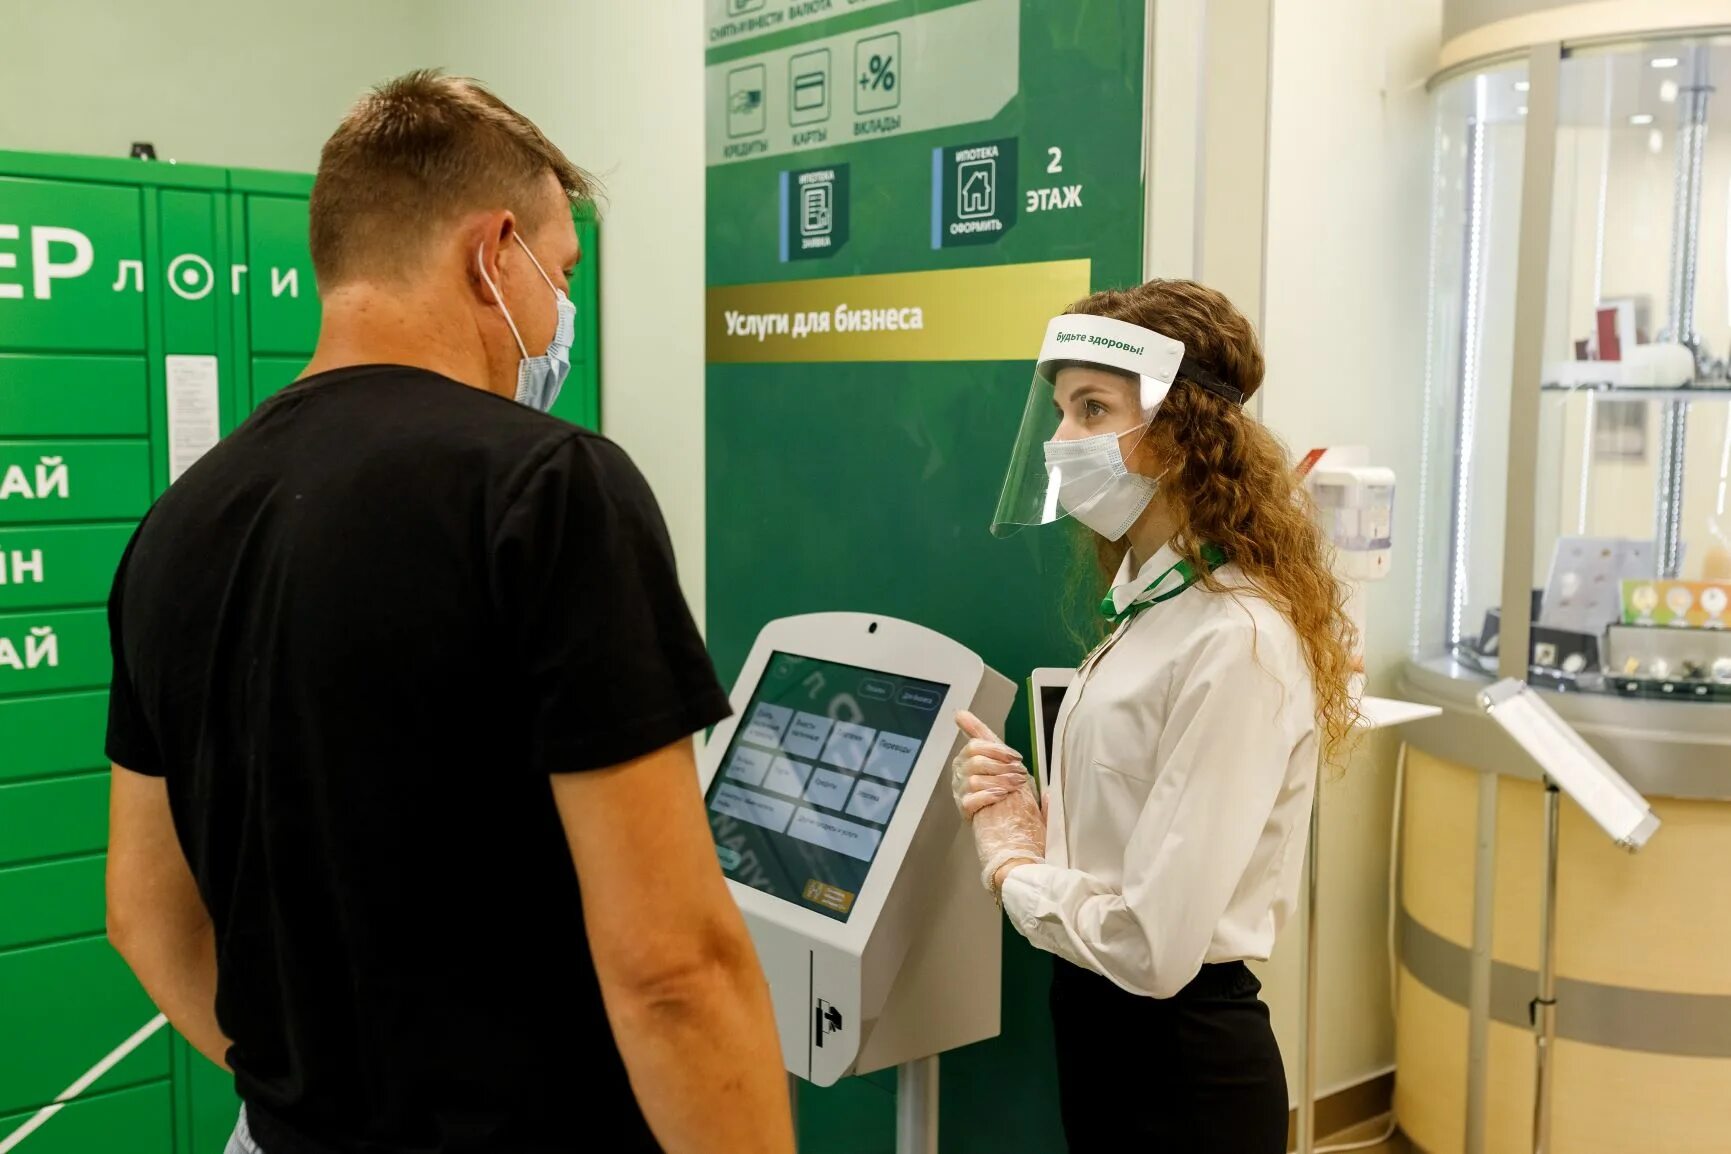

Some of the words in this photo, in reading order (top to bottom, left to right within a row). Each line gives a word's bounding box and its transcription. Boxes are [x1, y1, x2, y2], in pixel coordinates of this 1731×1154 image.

[792, 128, 827, 146] КАРТЫ
[853, 115, 901, 137] ВКЛАДЫ
[956, 146, 999, 162] ИПОТЕКА
[1047, 146, 1062, 173] 2
[1026, 184, 1083, 212] ЭТАЖ
[950, 219, 1002, 235] ОФОРМИТЬ
[724, 310, 789, 342] Услуги
[792, 311, 830, 338] для
[834, 303, 924, 332] бизнеса
[1088, 335, 1144, 355] здоровы!
[0, 456, 69, 499] АЙ
